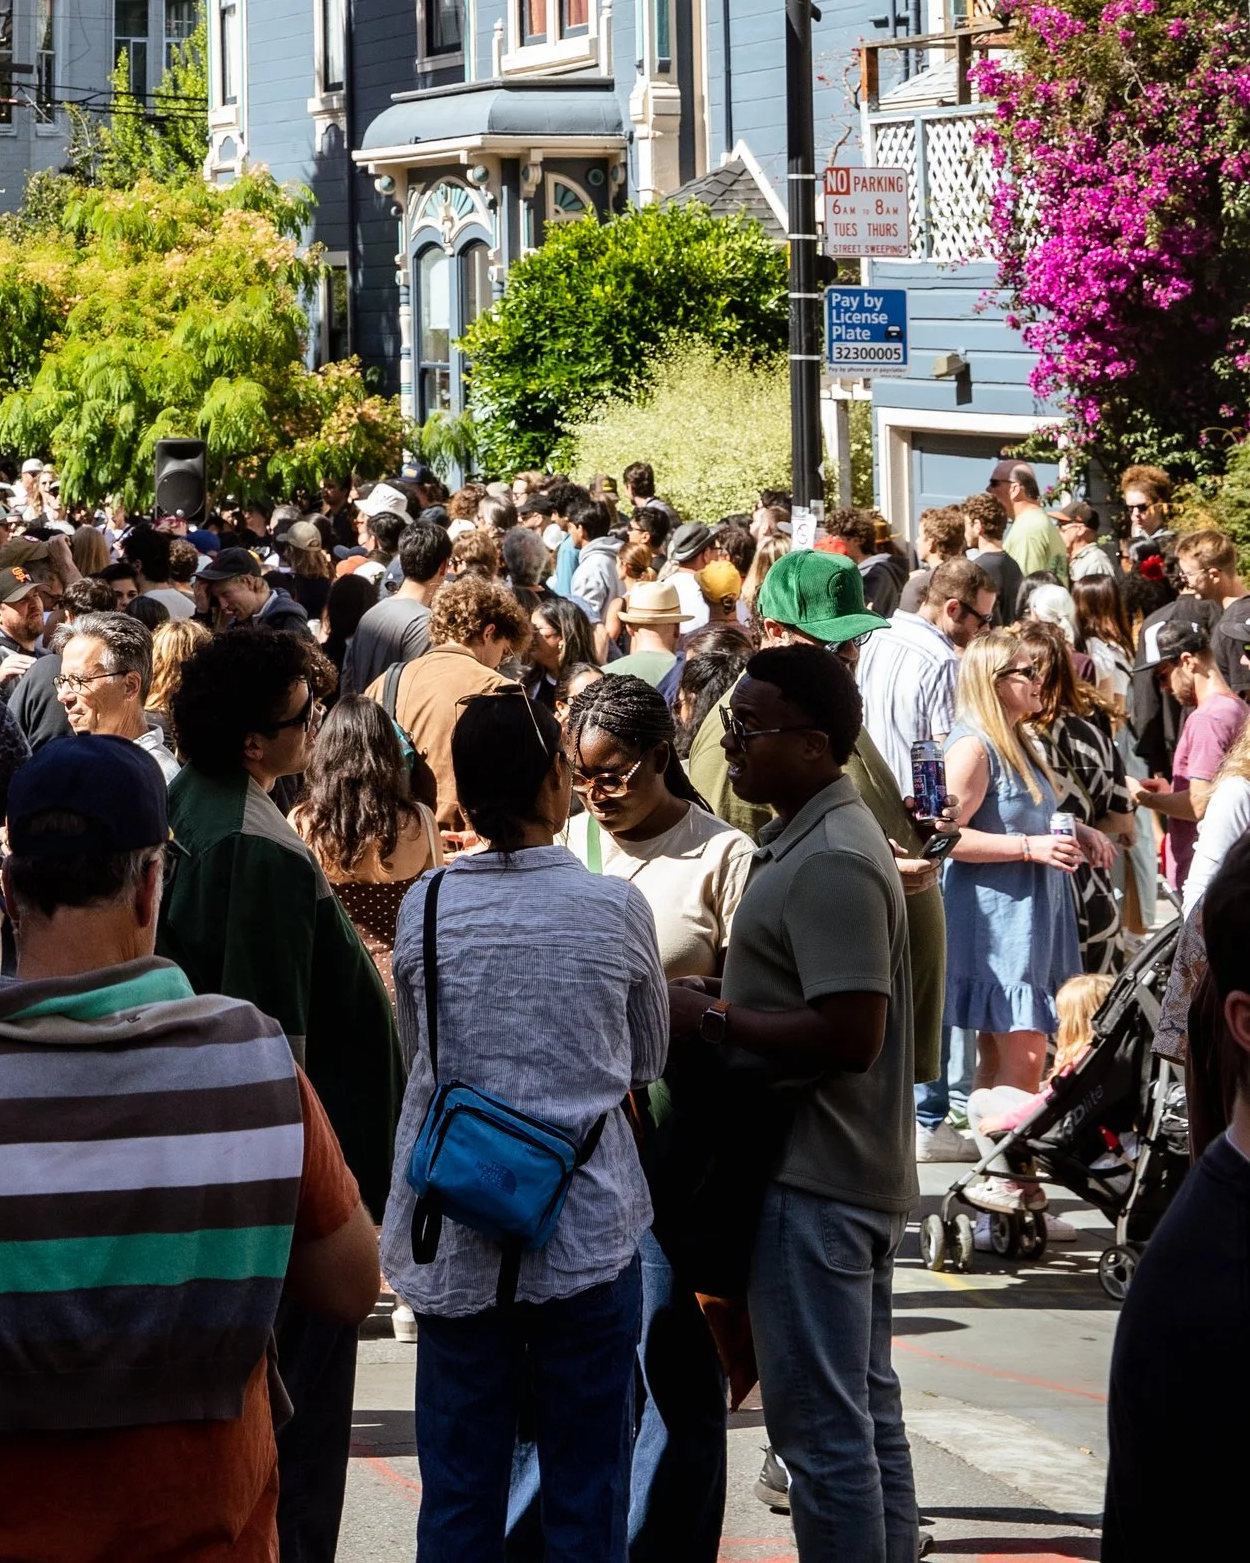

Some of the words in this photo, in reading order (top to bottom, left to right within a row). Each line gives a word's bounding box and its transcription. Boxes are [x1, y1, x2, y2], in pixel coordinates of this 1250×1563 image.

[826, 170, 848, 193] NO
[853, 176, 904, 193] PARKING
[834, 222, 858, 237] TUES
[867, 222, 899, 238] THURS
[833, 244, 862, 253] STREET
[865, 244, 903, 254] SWEEPING
[831, 292, 860, 311] Pay
[863, 292, 884, 311] by
[832, 309, 888, 324] License
[832, 324, 871, 340] Plate
[835, 347, 901, 360] 32300005
